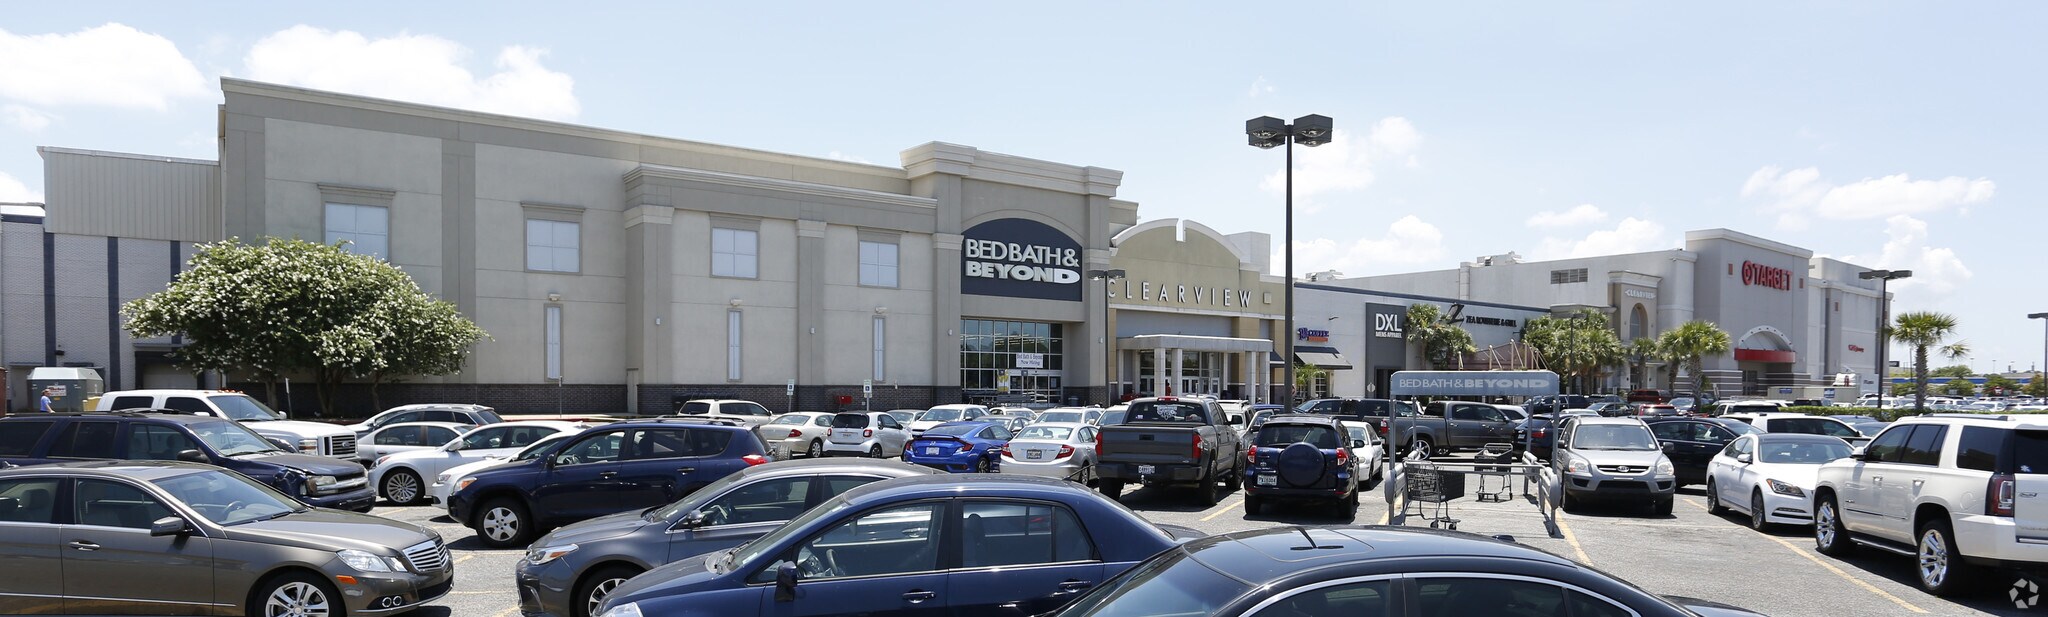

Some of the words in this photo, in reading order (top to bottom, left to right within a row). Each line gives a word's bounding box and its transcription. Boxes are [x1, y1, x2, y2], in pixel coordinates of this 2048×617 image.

[965, 238, 1008, 260] BED
[1008, 243, 1061, 266] BATH
[1062, 248, 1080, 267] &
[965, 260, 1080, 284] BEYOND
[1752, 263, 1792, 291] TARGET
[1108, 278, 1251, 308] CLEARVIEW
[1375, 313, 1402, 332] DXL
[1399, 379, 1421, 388] BED
[1422, 379, 1453, 388] BATH
[1454, 378, 1464, 388] &
[1465, 379, 1549, 388] BEYOND
